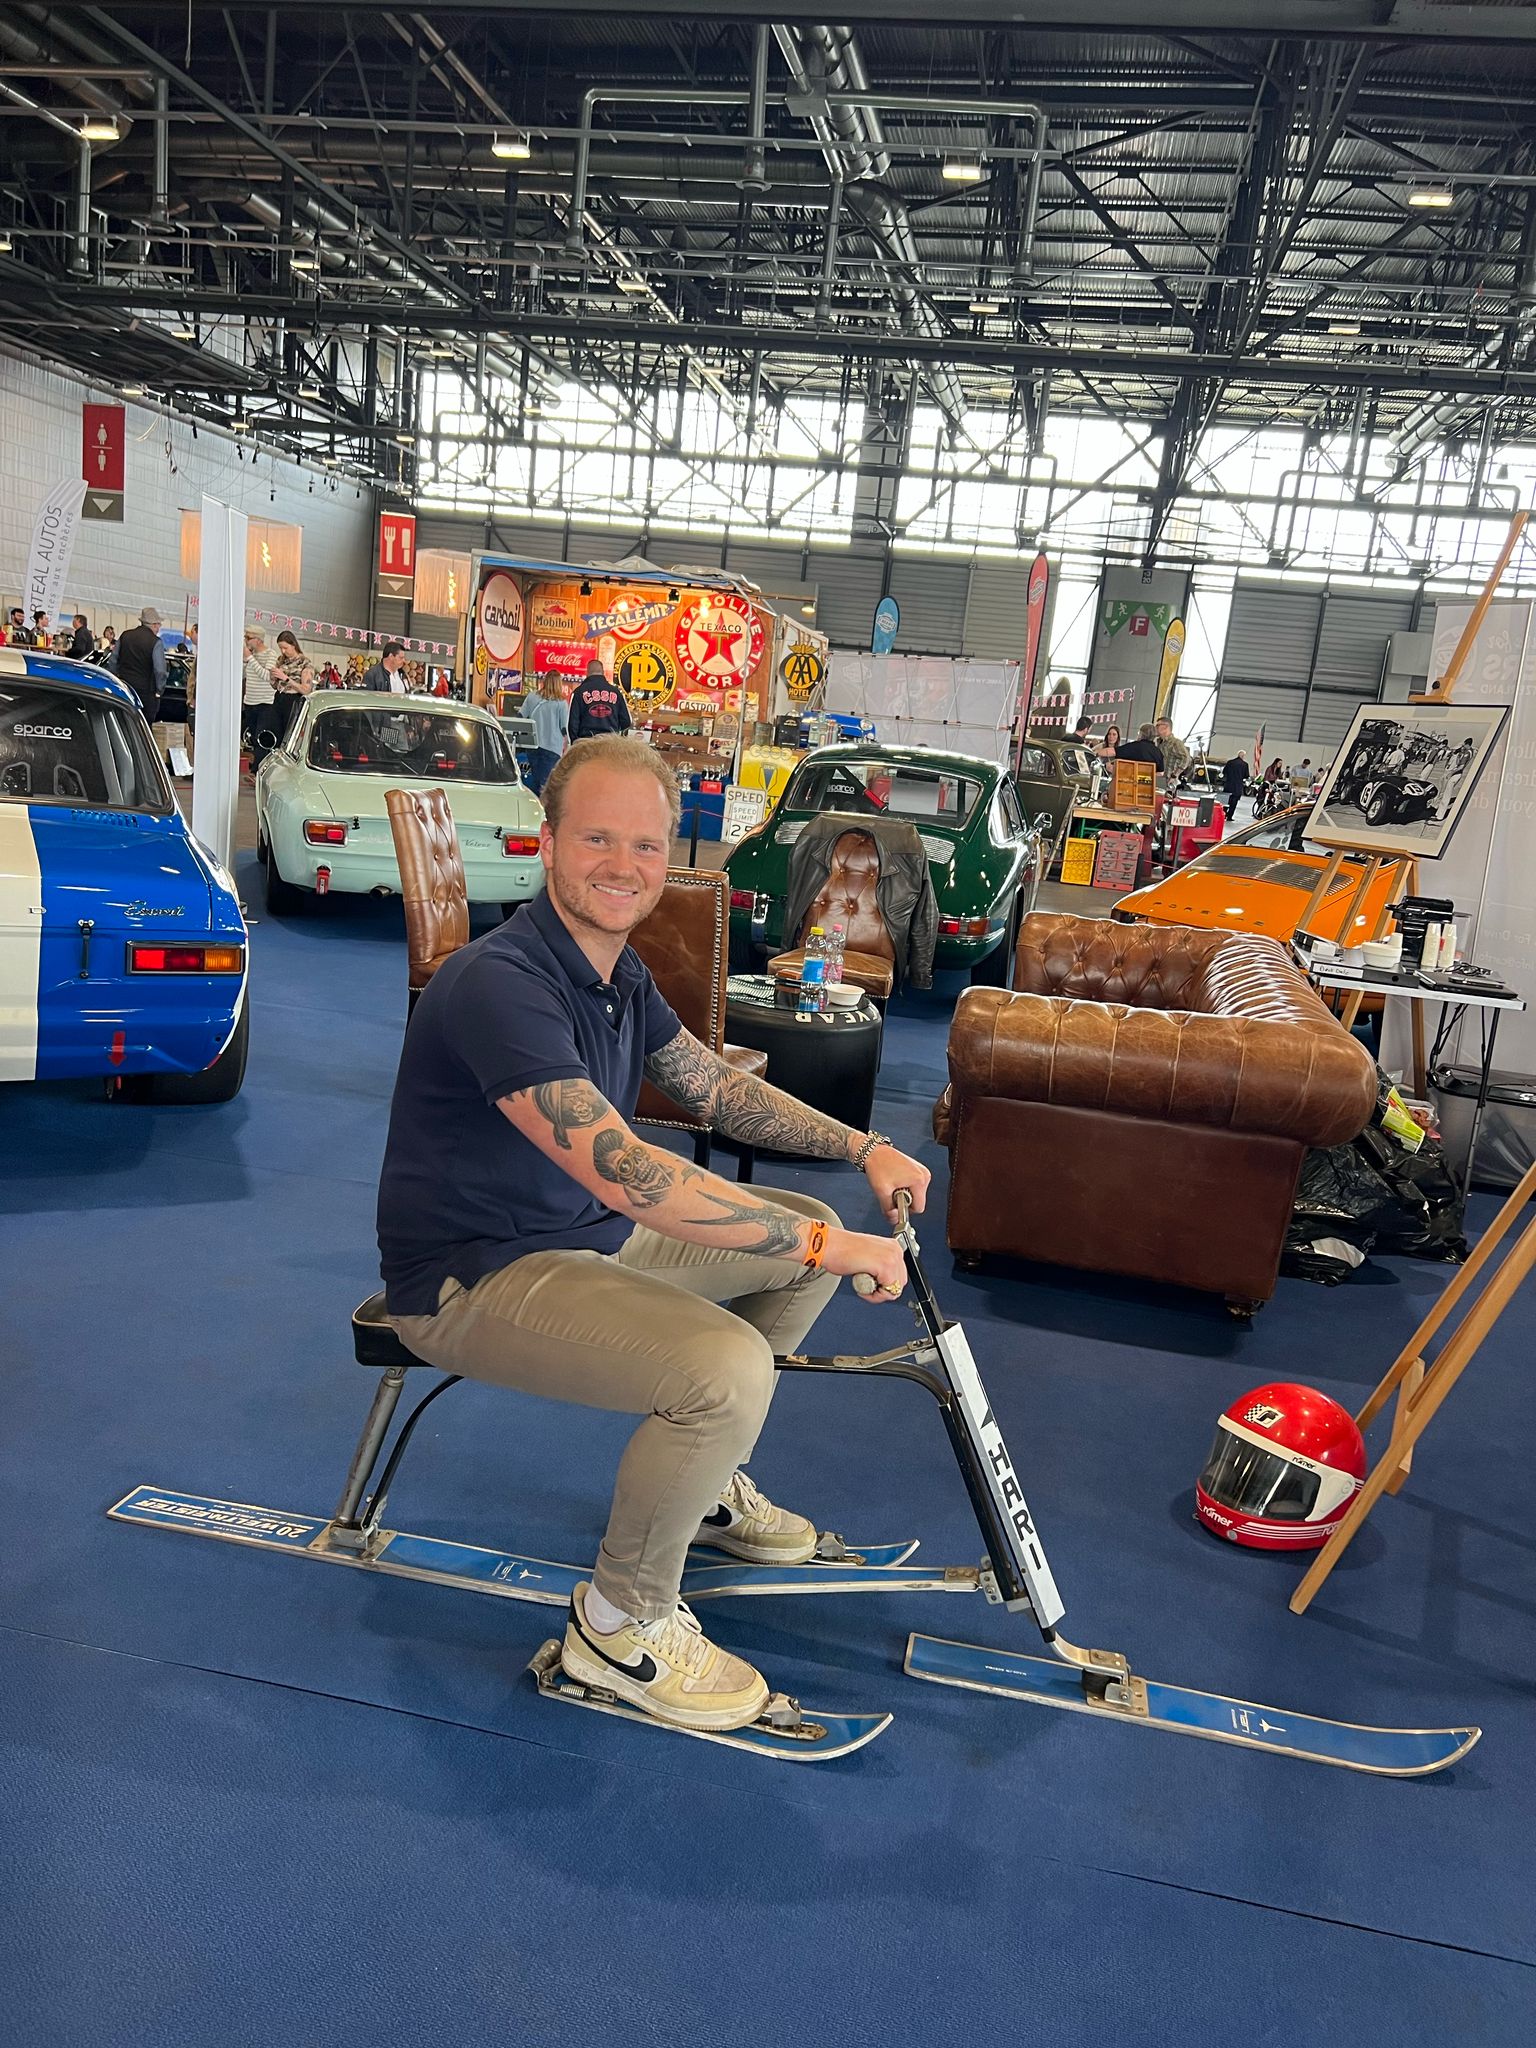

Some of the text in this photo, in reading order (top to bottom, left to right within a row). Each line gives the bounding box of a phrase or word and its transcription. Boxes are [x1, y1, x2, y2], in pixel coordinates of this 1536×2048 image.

[38, 505, 62, 562] AUTOS
[53, 568, 62, 586] aux
[58, 511, 74, 560] enchères
[484, 600, 521, 631] carboil
[535, 615, 574, 629] Mobiloil
[681, 595, 762, 635] GASOLINE
[700, 622, 742, 633] TEXACO
[1135, 618, 1145, 631] F
[545, 651, 583, 666] Coca-Cola
[677, 644, 762, 687] MOTOR OIL
[788, 687, 811, 697] HOTEL
[13, 724, 73, 738] sparco
[826, 784, 855, 794] sparco
[1407, 784, 1423, 794] 15
[727, 790, 764, 804] SPEED
[733, 806, 757, 815] SPEED
[1179, 809, 1190, 818] NO
[734, 814, 754, 822] LIMIT
[1173, 817, 1194, 825] PARKING
[1153, 901, 1265, 926] PORSCHE
[988, 1442, 1041, 1570] HARI
[134, 1499, 276, 1532] WELTMEISTER
[276, 1525, 309, 1539] 20
